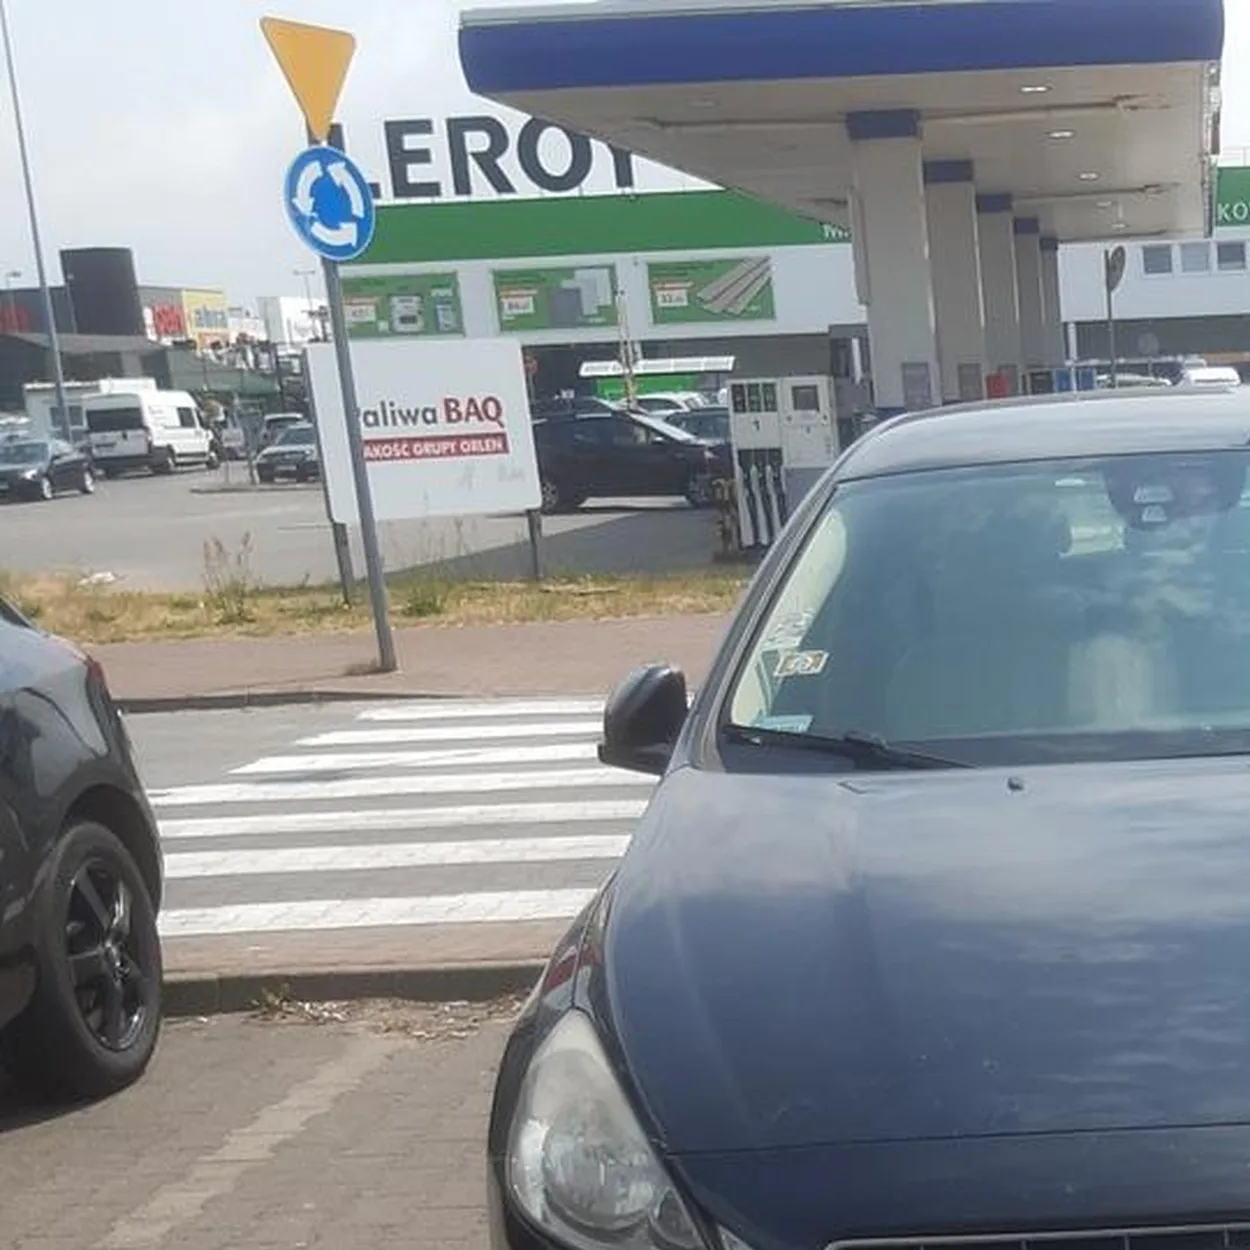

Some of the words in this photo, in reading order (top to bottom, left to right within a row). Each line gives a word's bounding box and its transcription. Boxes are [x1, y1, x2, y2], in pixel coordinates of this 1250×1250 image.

[326, 115, 634, 199] ERO
[362, 400, 438, 428] aliwa
[443, 396, 504, 428] BAQ
